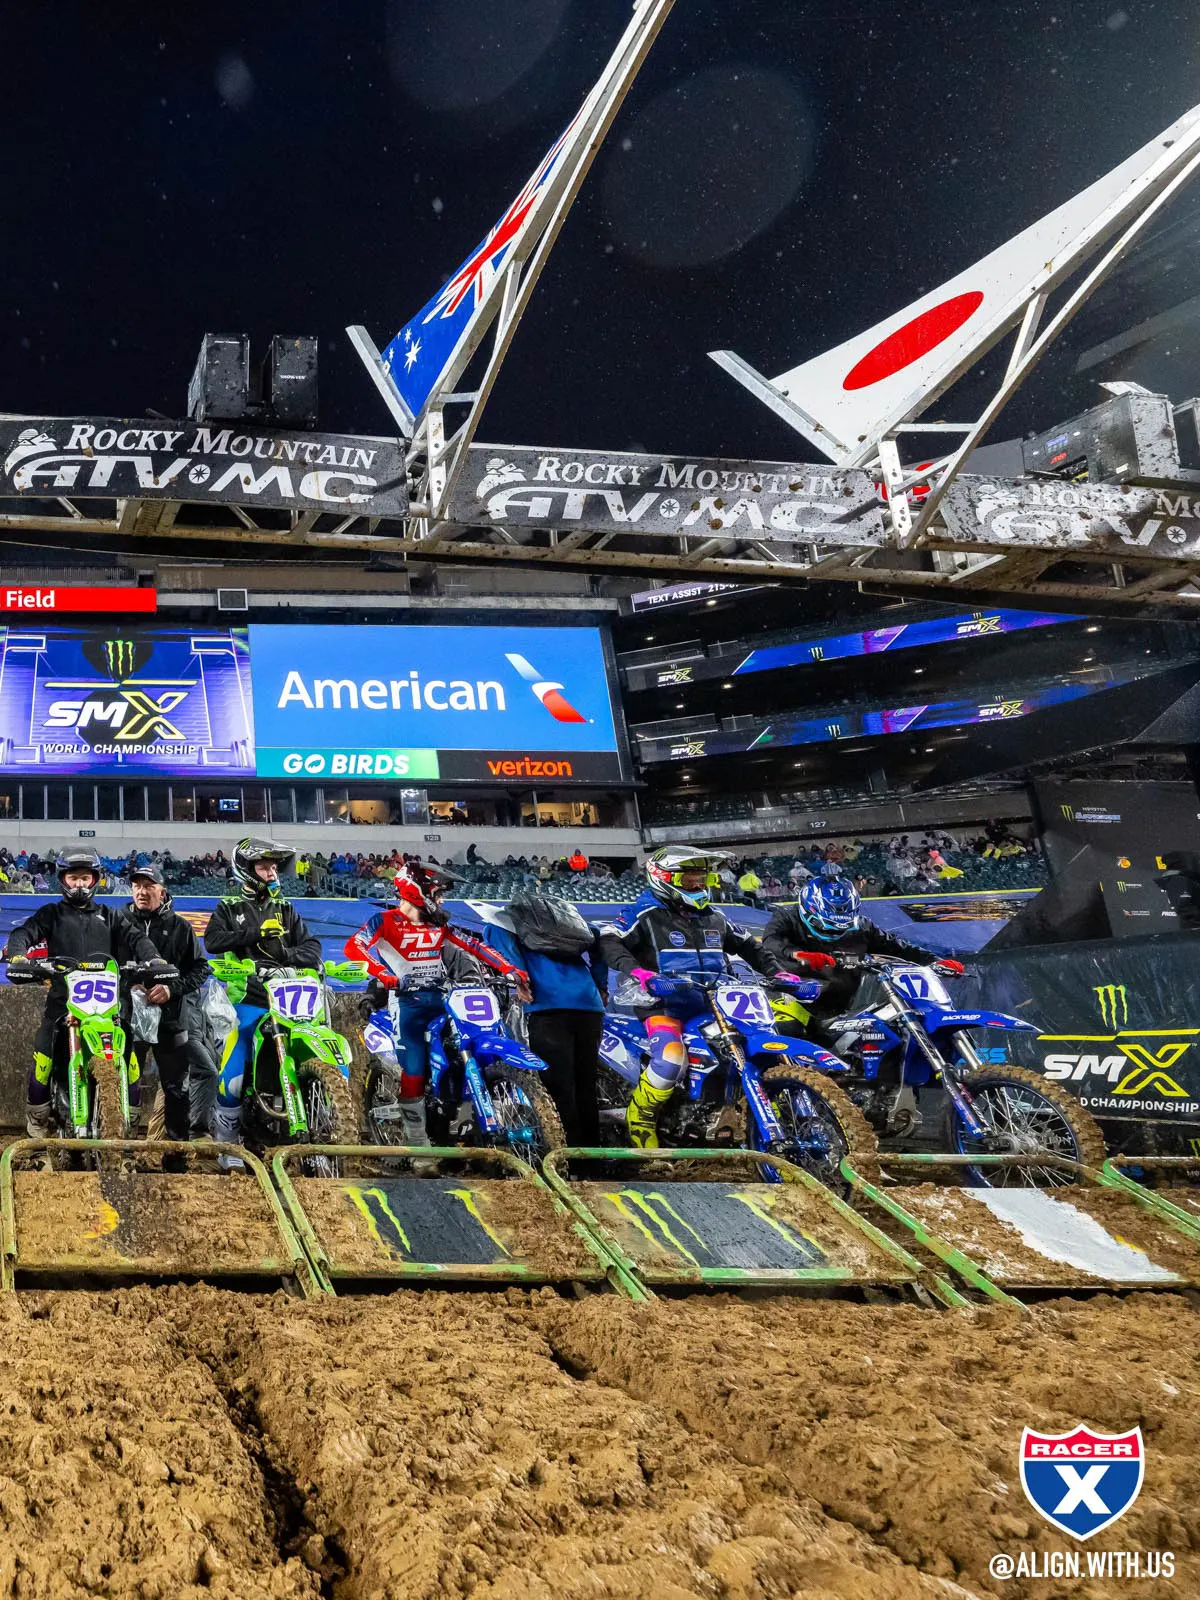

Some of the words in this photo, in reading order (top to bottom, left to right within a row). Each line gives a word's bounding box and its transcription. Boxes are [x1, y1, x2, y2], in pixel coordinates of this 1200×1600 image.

[62, 424, 185, 452] ROCKY
[187, 428, 377, 470] MOUNTAIN
[532, 456, 649, 486] ROCKY
[654, 462, 846, 498] MOUNTAIN
[6, 590, 56, 608] Field
[648, 593, 669, 605] TEXT
[671, 586, 703, 600] ASSIST
[957, 616, 1002, 635] SMX
[276, 670, 507, 712] American
[43, 690, 190, 741] SMX
[978, 702, 1024, 717] SMX
[42, 743, 91, 755] WORLD
[93, 744, 197, 756] CHAMPIONSHIP
[283, 753, 326, 774] GO
[331, 754, 411, 776] BIRDS
[487, 756, 573, 777] verizon
[809, 821, 827, 829] 127
[400, 932, 443, 949] FLY
[71, 979, 117, 1004] 95
[900, 973, 930, 999] 17
[273, 985, 319, 1016] 177
[463, 994, 494, 1021] 9
[1043, 1043, 1192, 1098] SMX
[1090, 1097, 1200, 1113] CHAMPIONSHIP
